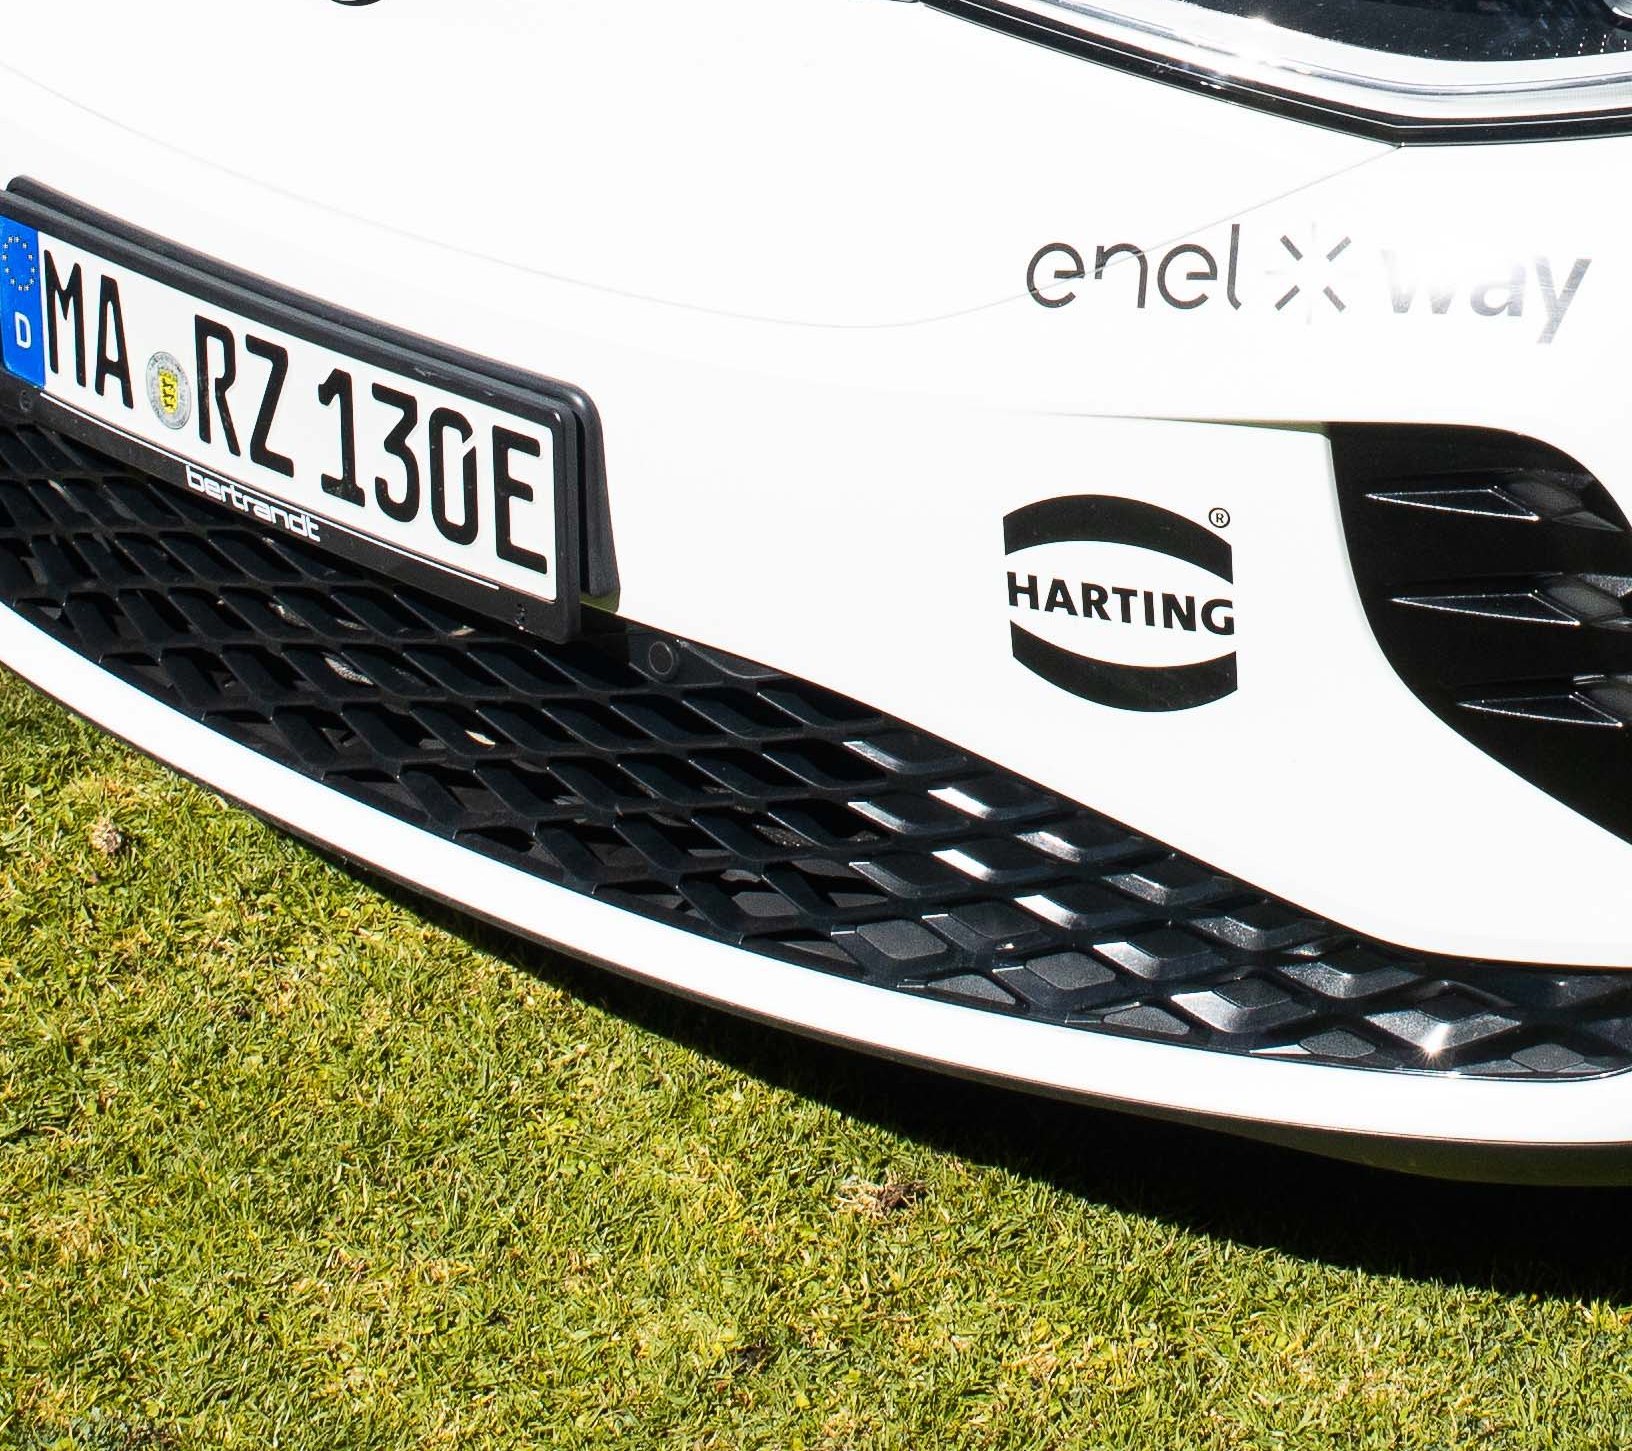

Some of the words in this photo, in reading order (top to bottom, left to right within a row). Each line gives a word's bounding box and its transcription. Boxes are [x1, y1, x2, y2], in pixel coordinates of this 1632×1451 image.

[1026, 222, 1243, 310] enel
[1380, 246, 1593, 346] way
[13, 311, 34, 348] D
[42, 250, 134, 410] MA
[193, 314, 294, 477] RZ
[319, 366, 549, 577] 130E
[185, 464, 320, 542] bertrandt
[1006, 572, 1235, 637] HARTING
